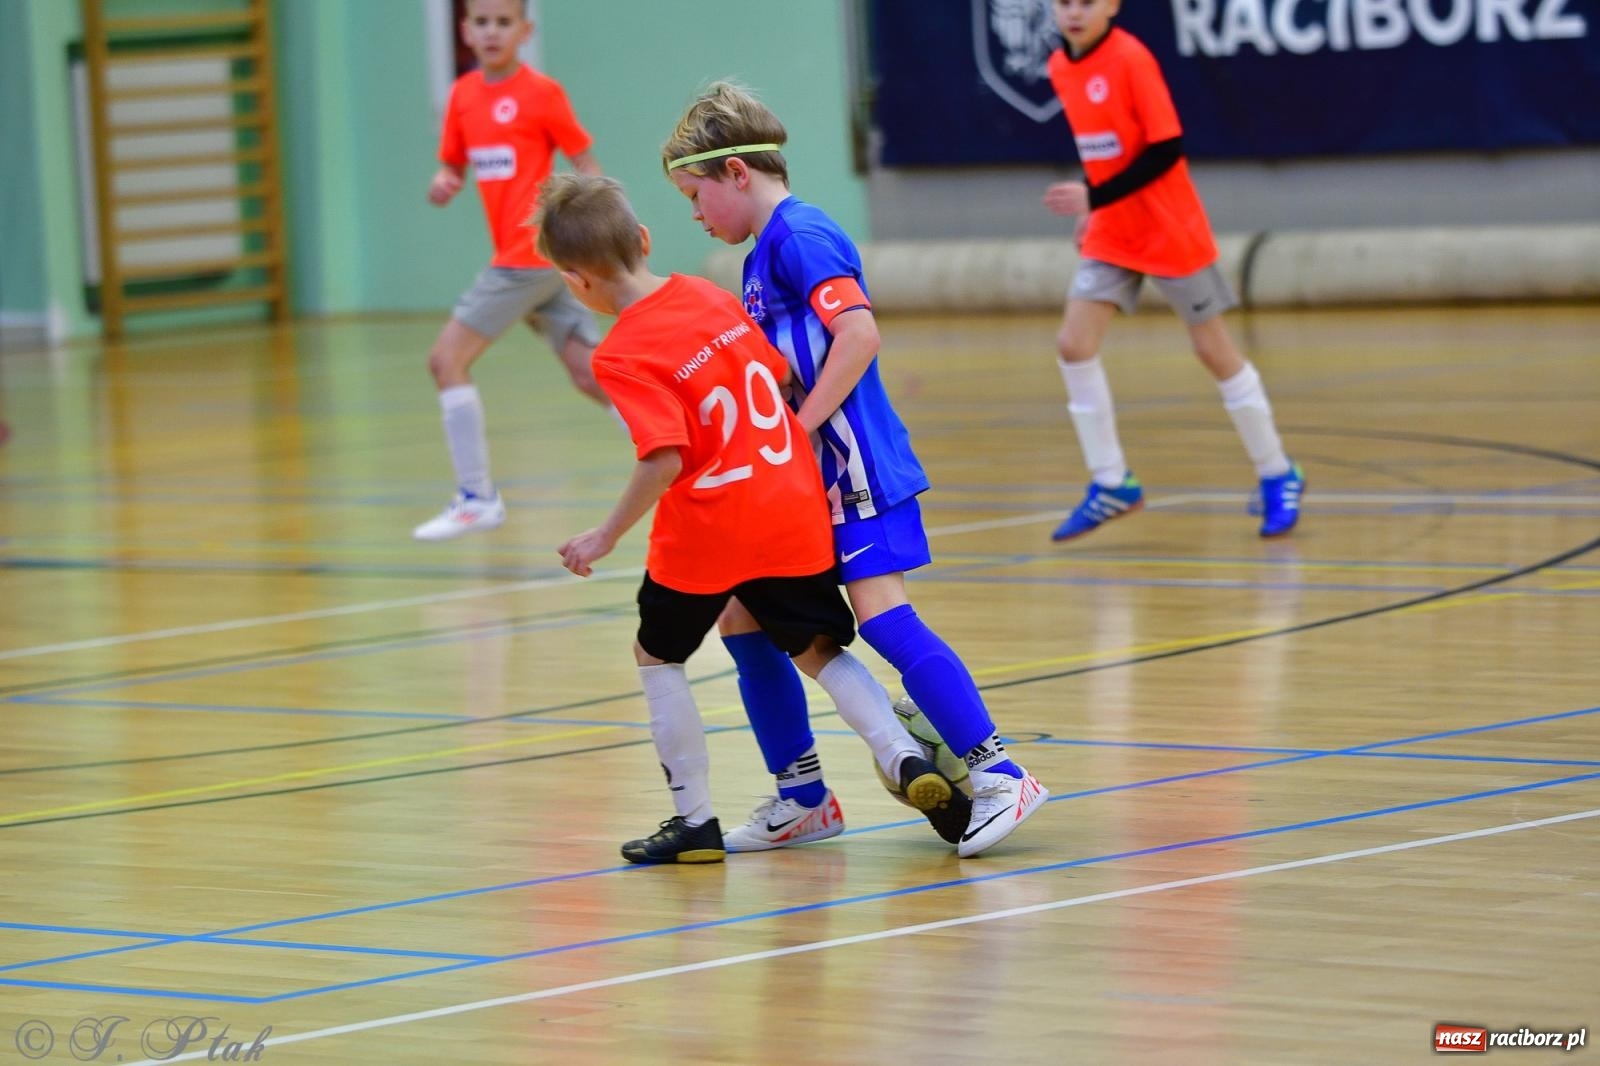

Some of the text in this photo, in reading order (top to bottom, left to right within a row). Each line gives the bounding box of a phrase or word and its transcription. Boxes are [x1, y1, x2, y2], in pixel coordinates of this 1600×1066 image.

[819, 285, 841, 310] C
[692, 360, 792, 489] 29
[968, 751, 996, 768] adidas
